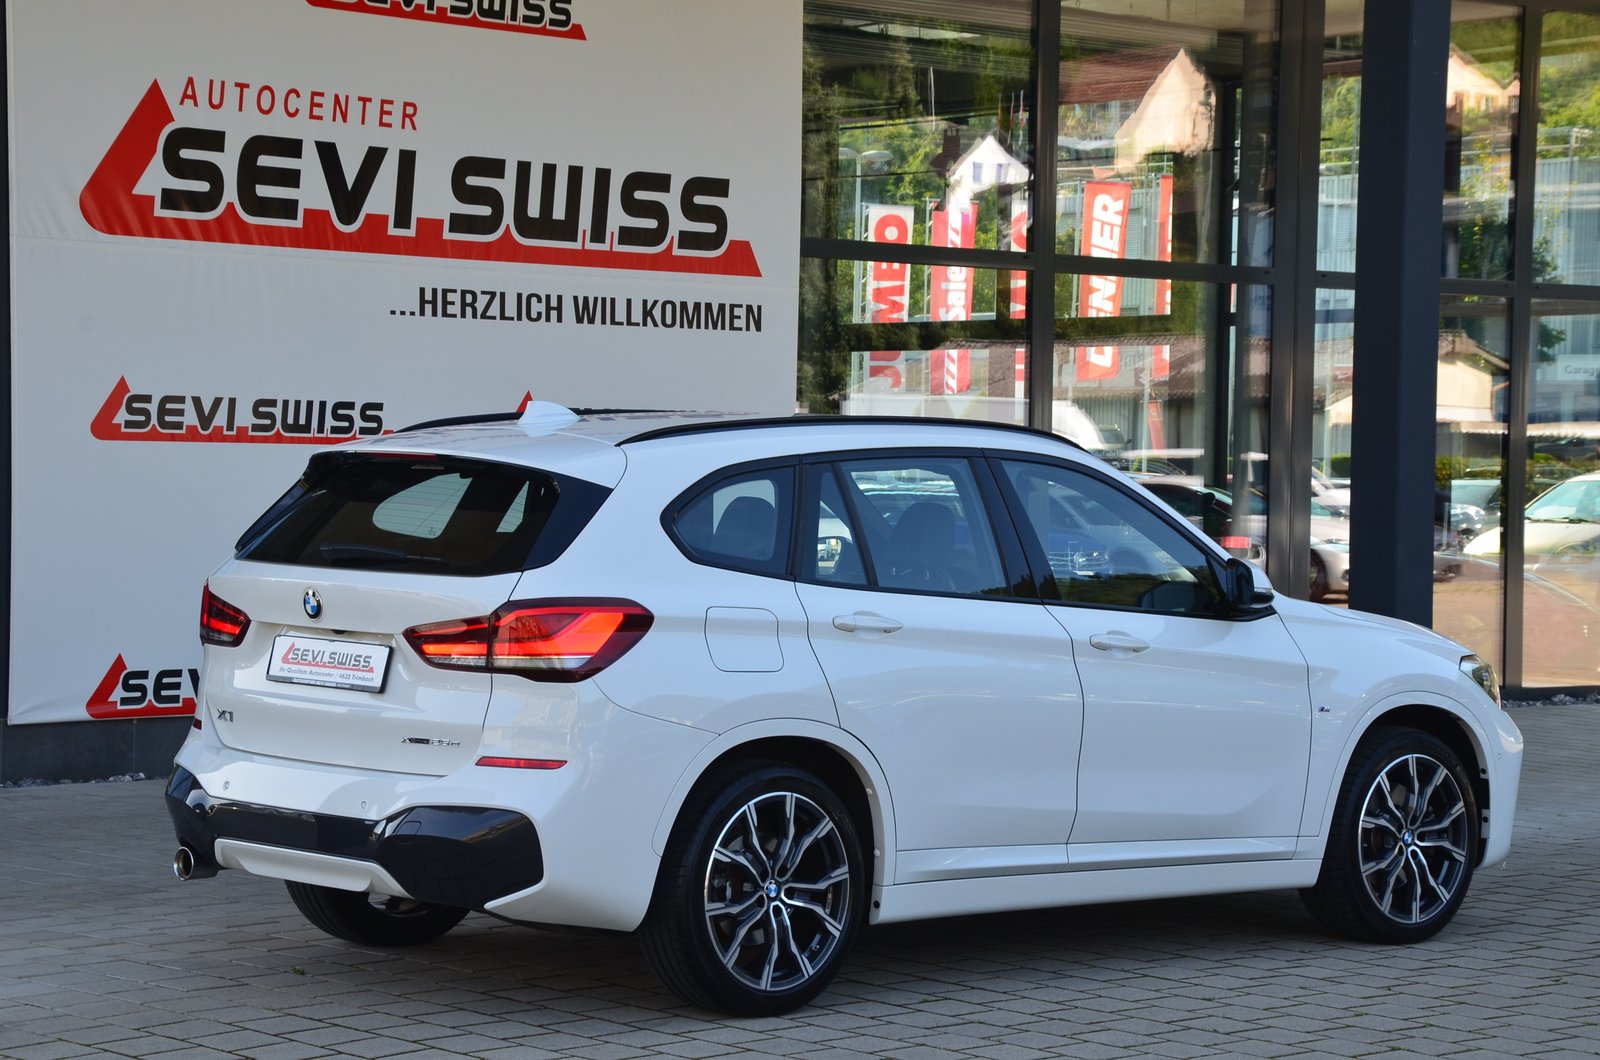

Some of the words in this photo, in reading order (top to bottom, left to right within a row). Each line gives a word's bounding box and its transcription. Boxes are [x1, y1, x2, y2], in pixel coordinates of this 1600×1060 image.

[179, 76, 418, 131] AUTOCENTER
[159, 126, 417, 230] SEVI
[448, 155, 731, 252] SWISS
[572, 295, 762, 333] WILLKOMMEN
[123, 393, 237, 434] SEVI
[250, 398, 384, 436] SWISS
[290, 648, 326, 664] SEVI
[327, 651, 372, 669] SWISS
[217, 708, 234, 723] X1
